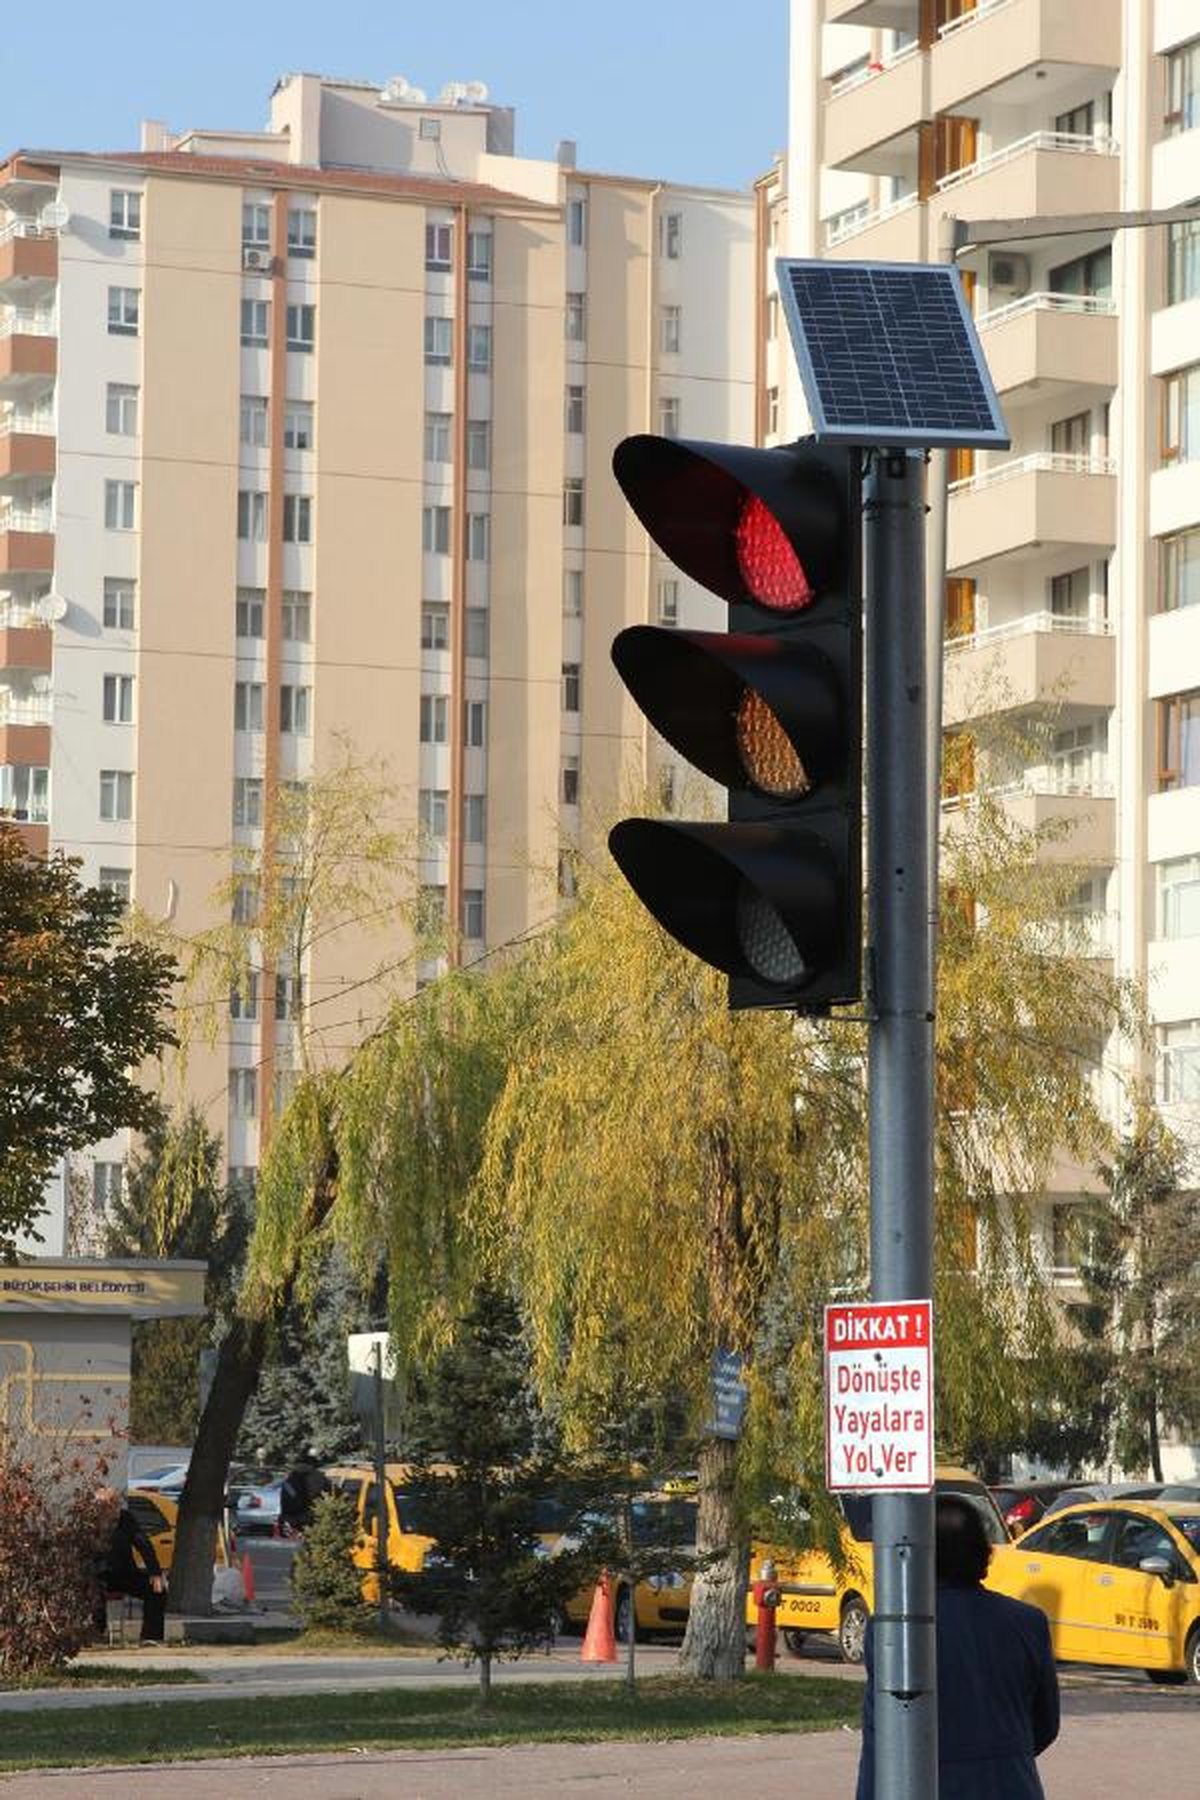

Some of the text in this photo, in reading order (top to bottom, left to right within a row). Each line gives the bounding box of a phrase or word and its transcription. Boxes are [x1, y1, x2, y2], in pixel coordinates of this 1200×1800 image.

[834, 1312, 923, 1342] DİKKAT !
[837, 1363, 921, 1395] Dönüşte
[834, 1404, 925, 1440] Yayalara
[843, 1444, 917, 1473] Yol Ver
[790, 1600, 821, 1613] 0002
